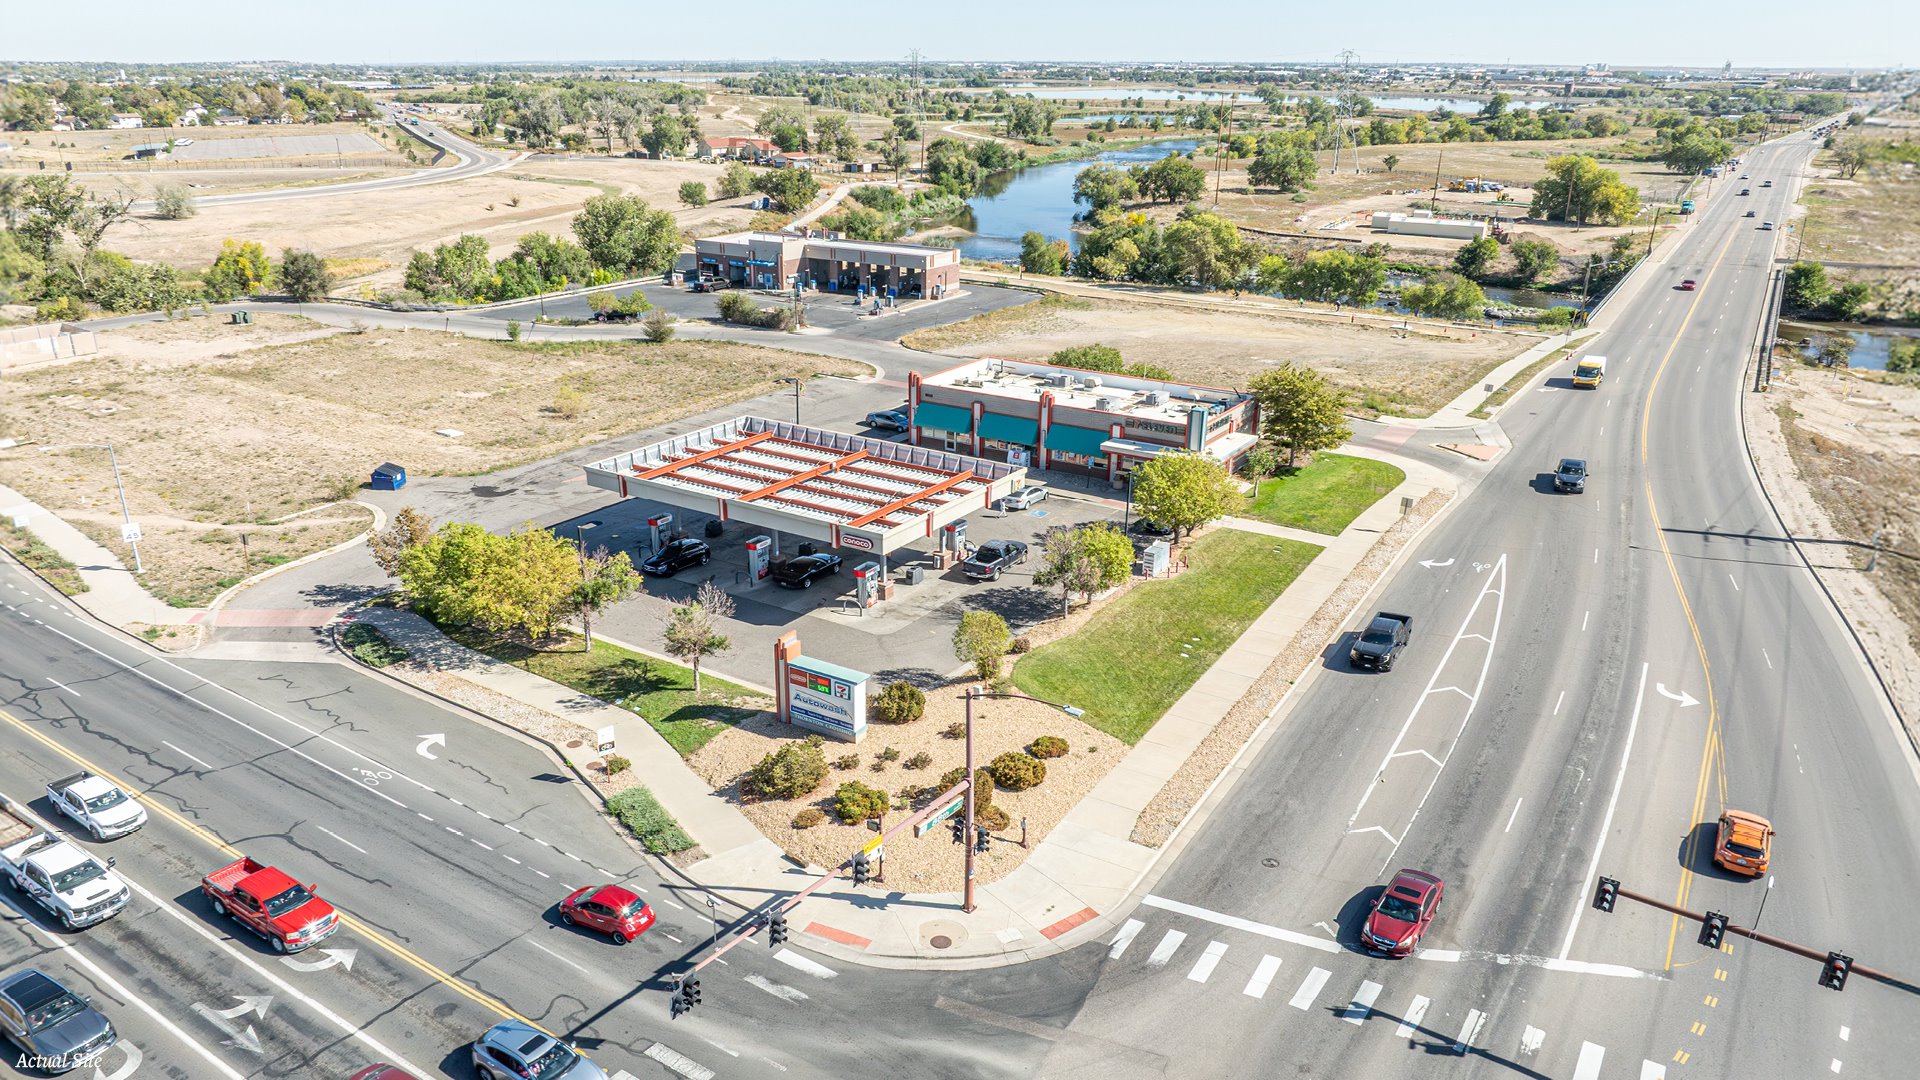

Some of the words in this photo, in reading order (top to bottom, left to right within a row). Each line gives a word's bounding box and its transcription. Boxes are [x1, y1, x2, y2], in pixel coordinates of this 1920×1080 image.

[843, 537, 869, 548] conoco
[794, 692, 847, 716] Autowash
[795, 714, 824, 728] THORNTON
[825, 724, 853, 736] CROSSING
